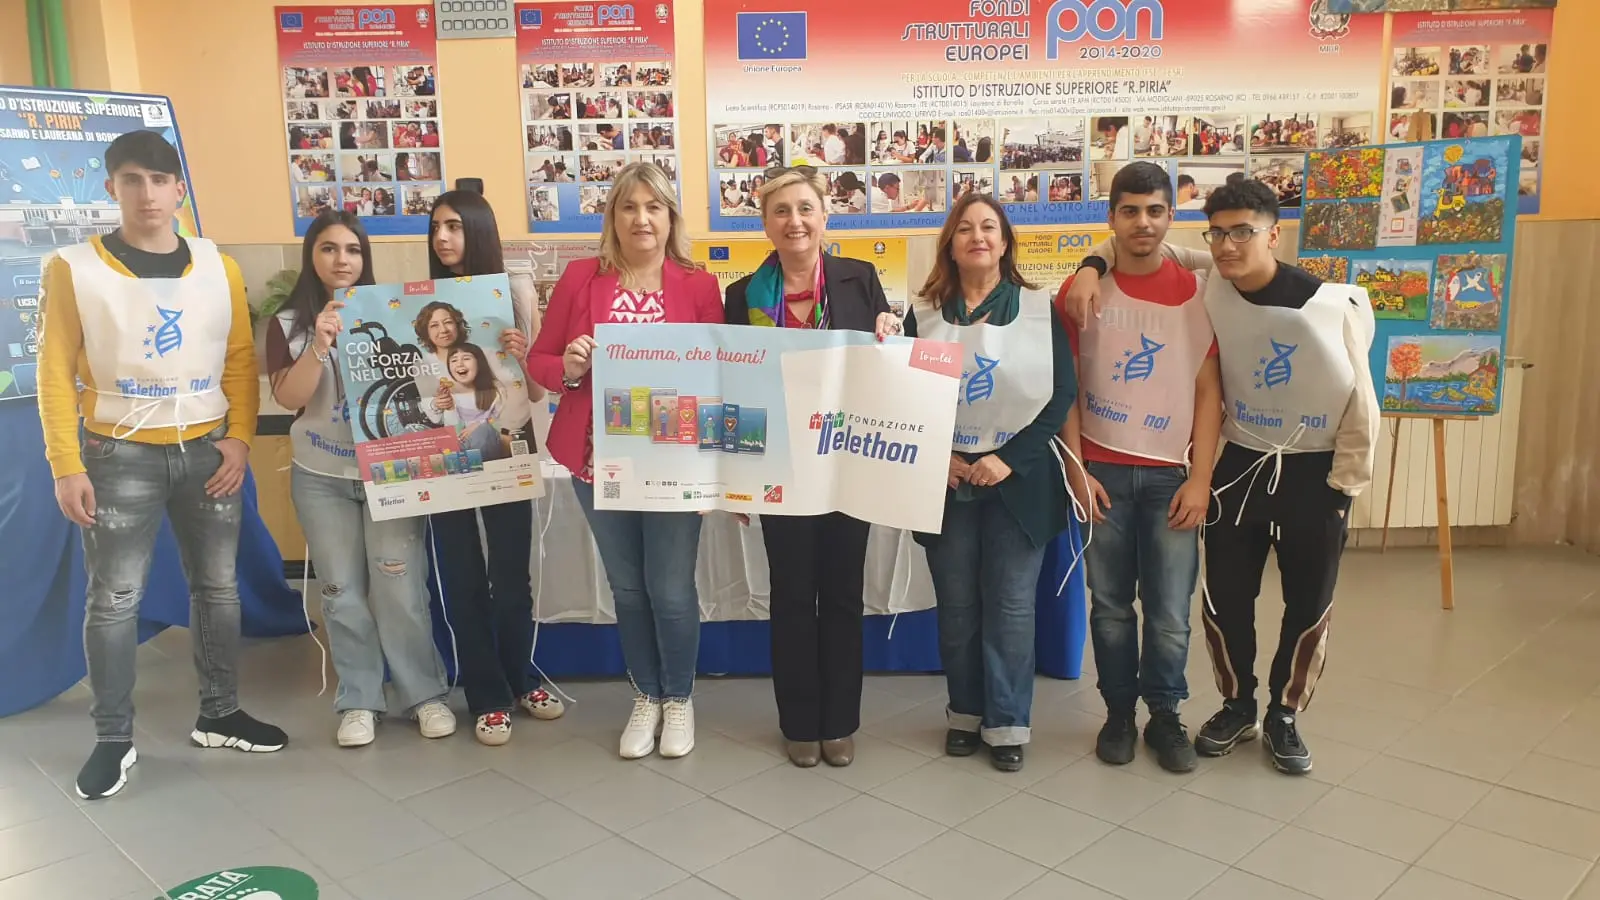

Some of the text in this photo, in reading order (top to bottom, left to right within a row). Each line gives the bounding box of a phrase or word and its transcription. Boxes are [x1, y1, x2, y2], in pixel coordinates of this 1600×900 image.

[597, 4, 635, 26] pon
[969, 0, 1029, 17] FONDI
[358, 8, 396, 30] pon
[901, 22, 1029, 40] STRUTTURALI
[1046, 0, 1163, 60] pon
[945, 44, 1029, 61] EUROPEI
[1079, 45, 1162, 60] 2014-2020
[743, 65, 770, 73] Unione
[912, 84, 965, 99] ISTITUTO
[969, 82, 1051, 98] D'ISTRUZIONE
[1055, 81, 1119, 95] SUPERIORE
[8, 98, 83, 114] D'ISTRUZIONE
[84, 103, 143, 118] SUPERIORE
[0, 128, 31, 140] SARNO
[31, 129, 39, 140] E
[40, 130, 84, 142] LAUREANA
[84, 132, 96, 142] DI
[1020, 204, 1038, 214] NEL
[1042, 202, 1084, 213] VOSTRO
[1057, 234, 1092, 253] pon
[345, 340, 381, 356] CON
[606, 343, 767, 364] Mamma, che buoni!
[348, 352, 424, 369] LA FORZA
[351, 362, 441, 382] NEL CUORE
[847, 413, 925, 433] FONDAZIONE
[1143, 414, 1171, 431] noi
[1235, 399, 1328, 429] Telethon noi
[808, 411, 919, 465] Telethon
